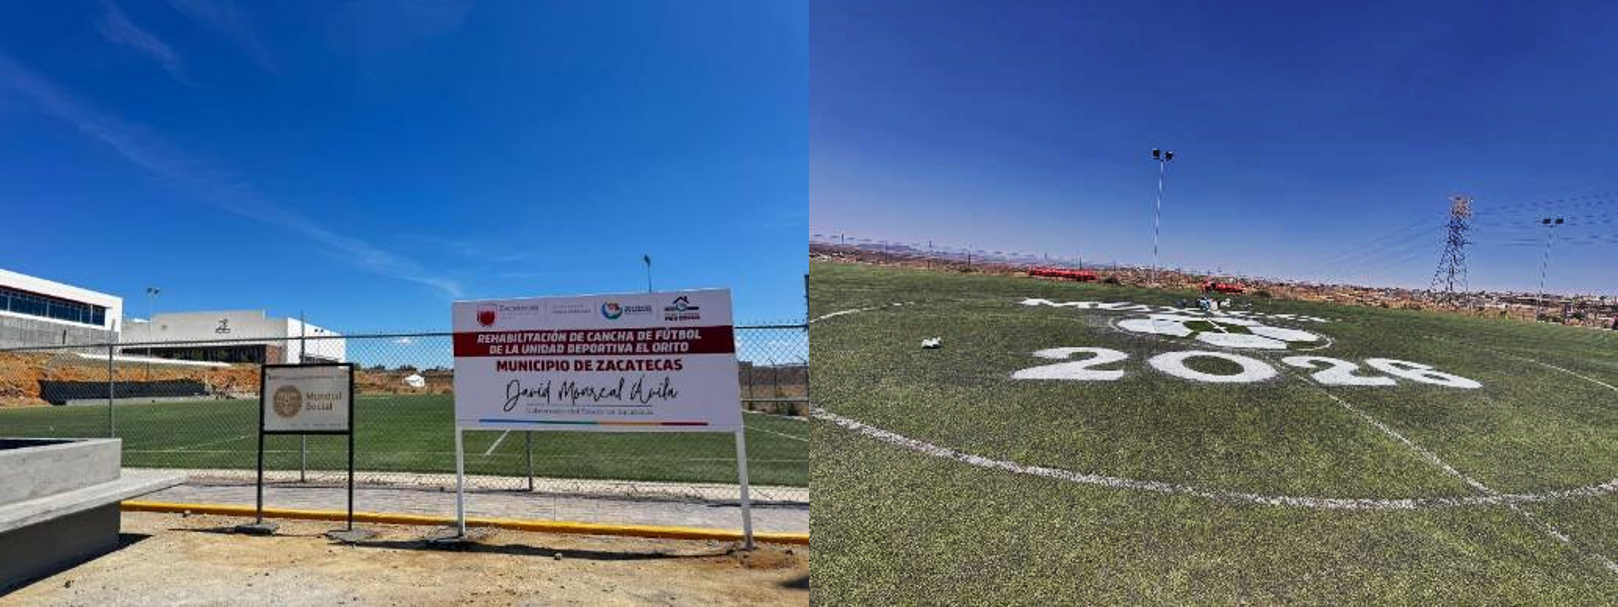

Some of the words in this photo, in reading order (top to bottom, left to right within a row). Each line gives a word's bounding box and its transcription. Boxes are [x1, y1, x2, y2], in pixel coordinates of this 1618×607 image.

[476, 329, 566, 344] REHABILITACIÓN
[569, 332, 585, 342] DE
[586, 331, 635, 342] CANCHA
[636, 331, 652, 341] DE
[654, 328, 702, 341] FÚTBOL
[489, 344, 504, 355] DE
[505, 344, 519, 355] LA
[521, 343, 565, 355] UNIDAD
[567, 343, 634, 354] DEPORTIVA
[634, 343, 649, 354] EL
[651, 342, 690, 353] ORITO
[496, 359, 571, 372] MUNICIPIO
[573, 359, 593, 372] DE
[594, 358, 684, 372] ZACATECAS
[1012, 346, 1483, 389] 2026
[305, 391, 342, 402] Mundial
[503, 379, 551, 412] David
[558, 377, 625, 406] Monreal
[305, 401, 333, 411] Social
